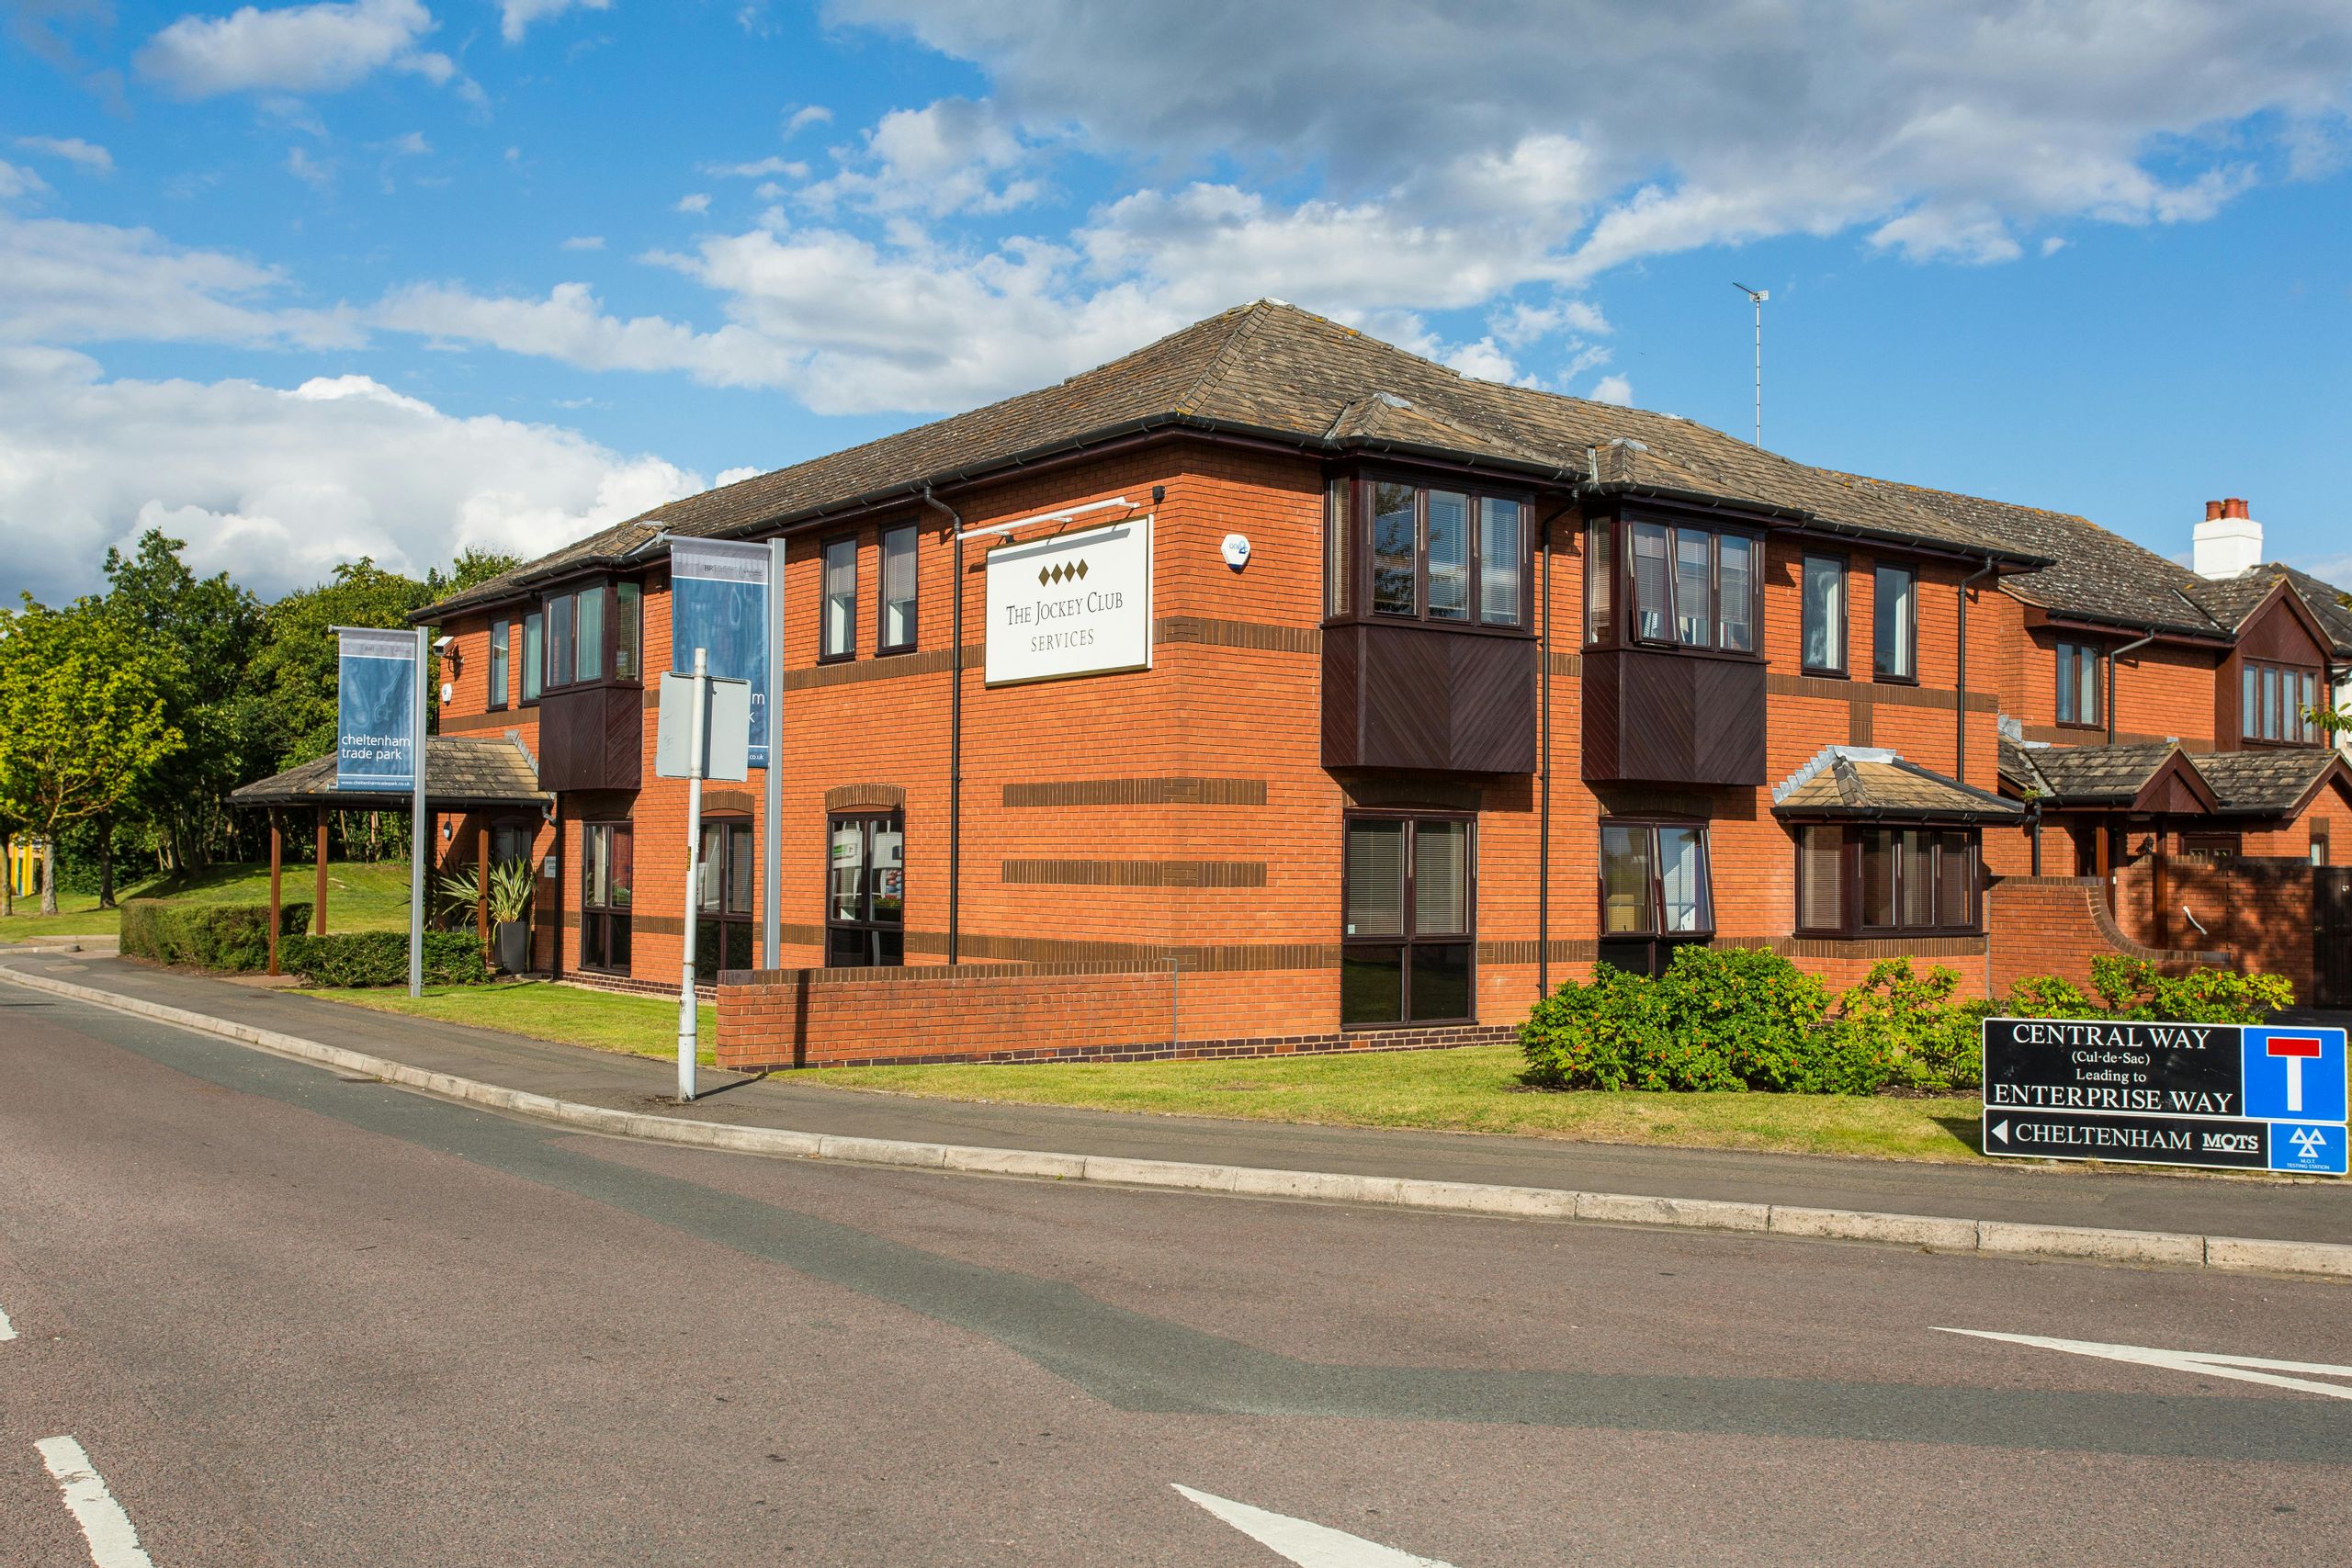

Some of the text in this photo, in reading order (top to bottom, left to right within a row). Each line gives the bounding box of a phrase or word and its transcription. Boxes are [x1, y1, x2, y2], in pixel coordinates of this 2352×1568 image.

[1006, 592, 1123, 626] THE JOCKEY CLUB
[1031, 628, 1094, 652] SERVICES
[341, 734, 410, 747] cheltenham
[341, 747, 402, 761] trade park
[2012, 1024, 2211, 1050] CENTRAL WAY
[2072, 1051, 2151, 1066] (Cul-de-Sac)
[2075, 1068, 2147, 1084] Leading to
[1994, 1084, 2233, 1113] ENTERPRISE WAY
[2015, 1123, 2259, 1150] CHELTENHAM MOTS
